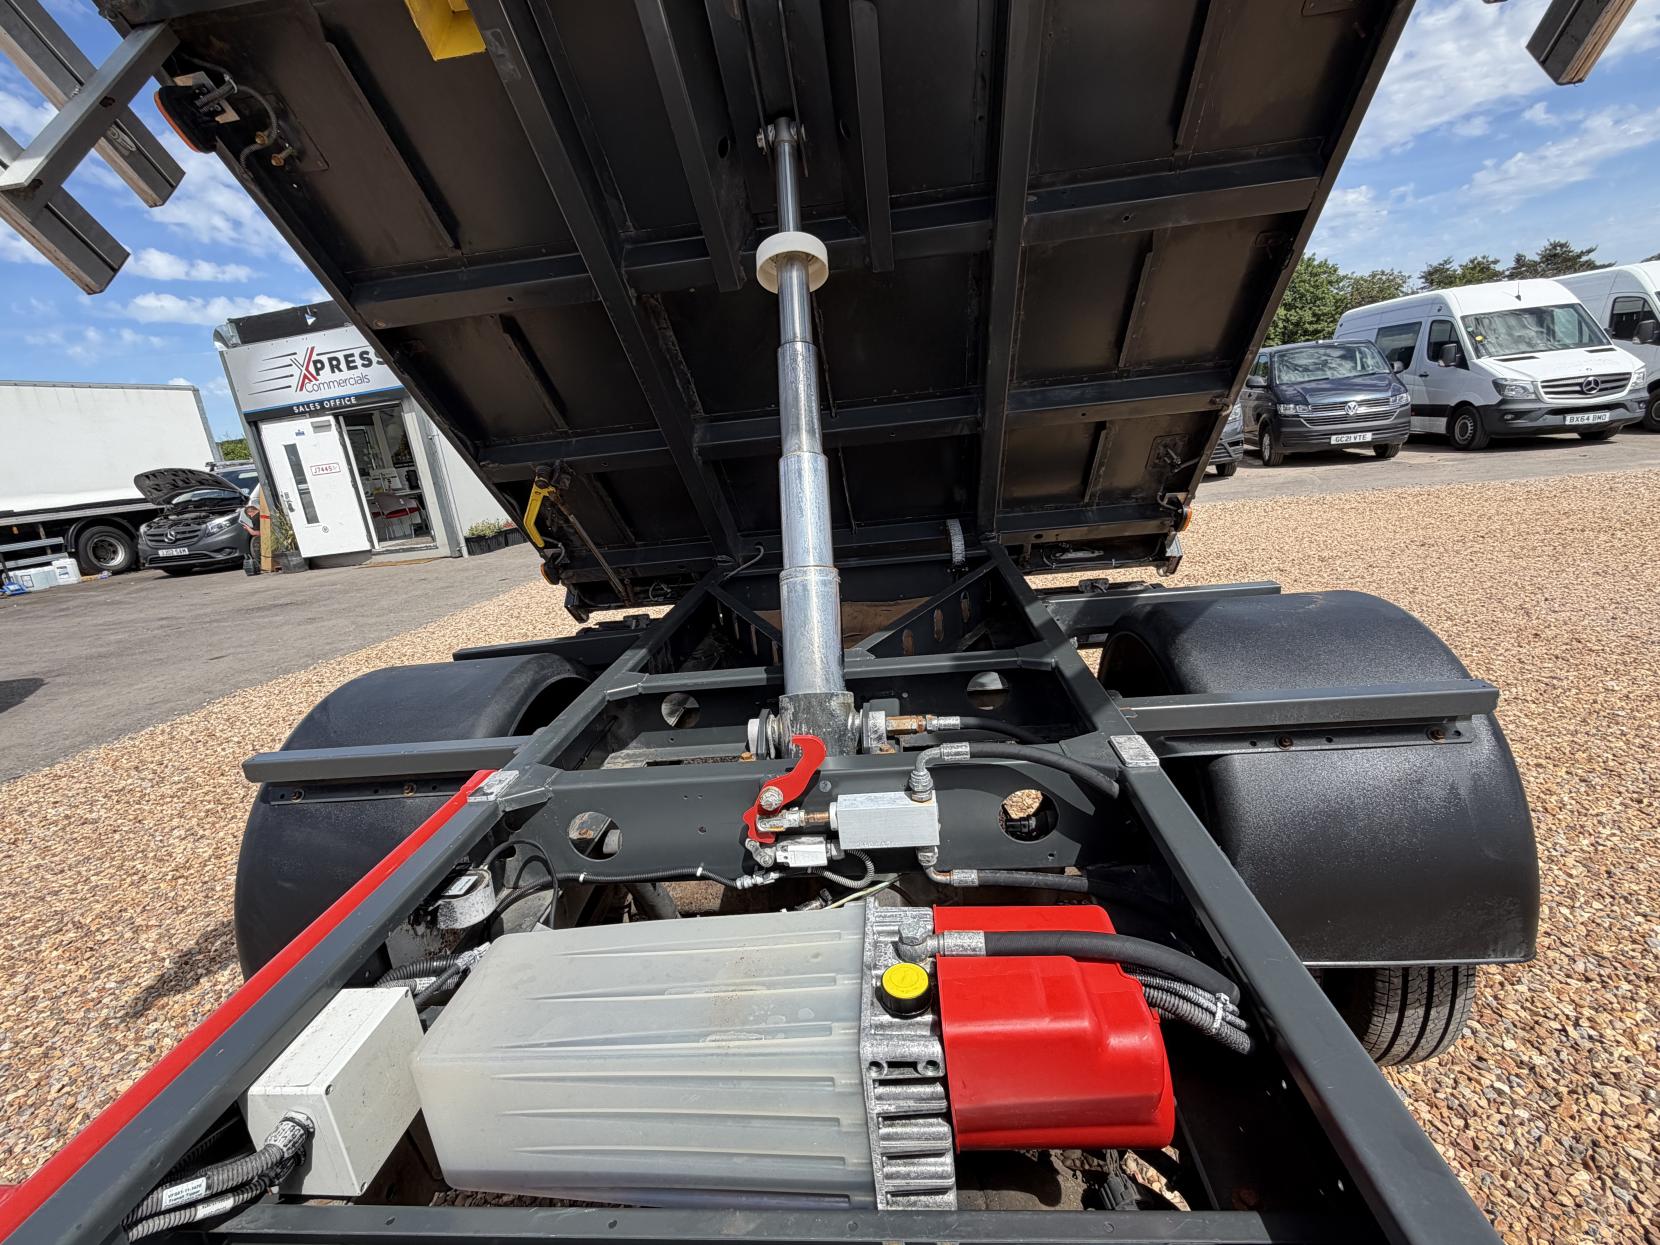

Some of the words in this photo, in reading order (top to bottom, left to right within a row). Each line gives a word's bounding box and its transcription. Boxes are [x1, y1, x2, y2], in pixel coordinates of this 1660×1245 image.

[305, 373, 371, 393] Commercials
[293, 402, 321, 413] SALES
[324, 396, 357, 408] OFFICE
